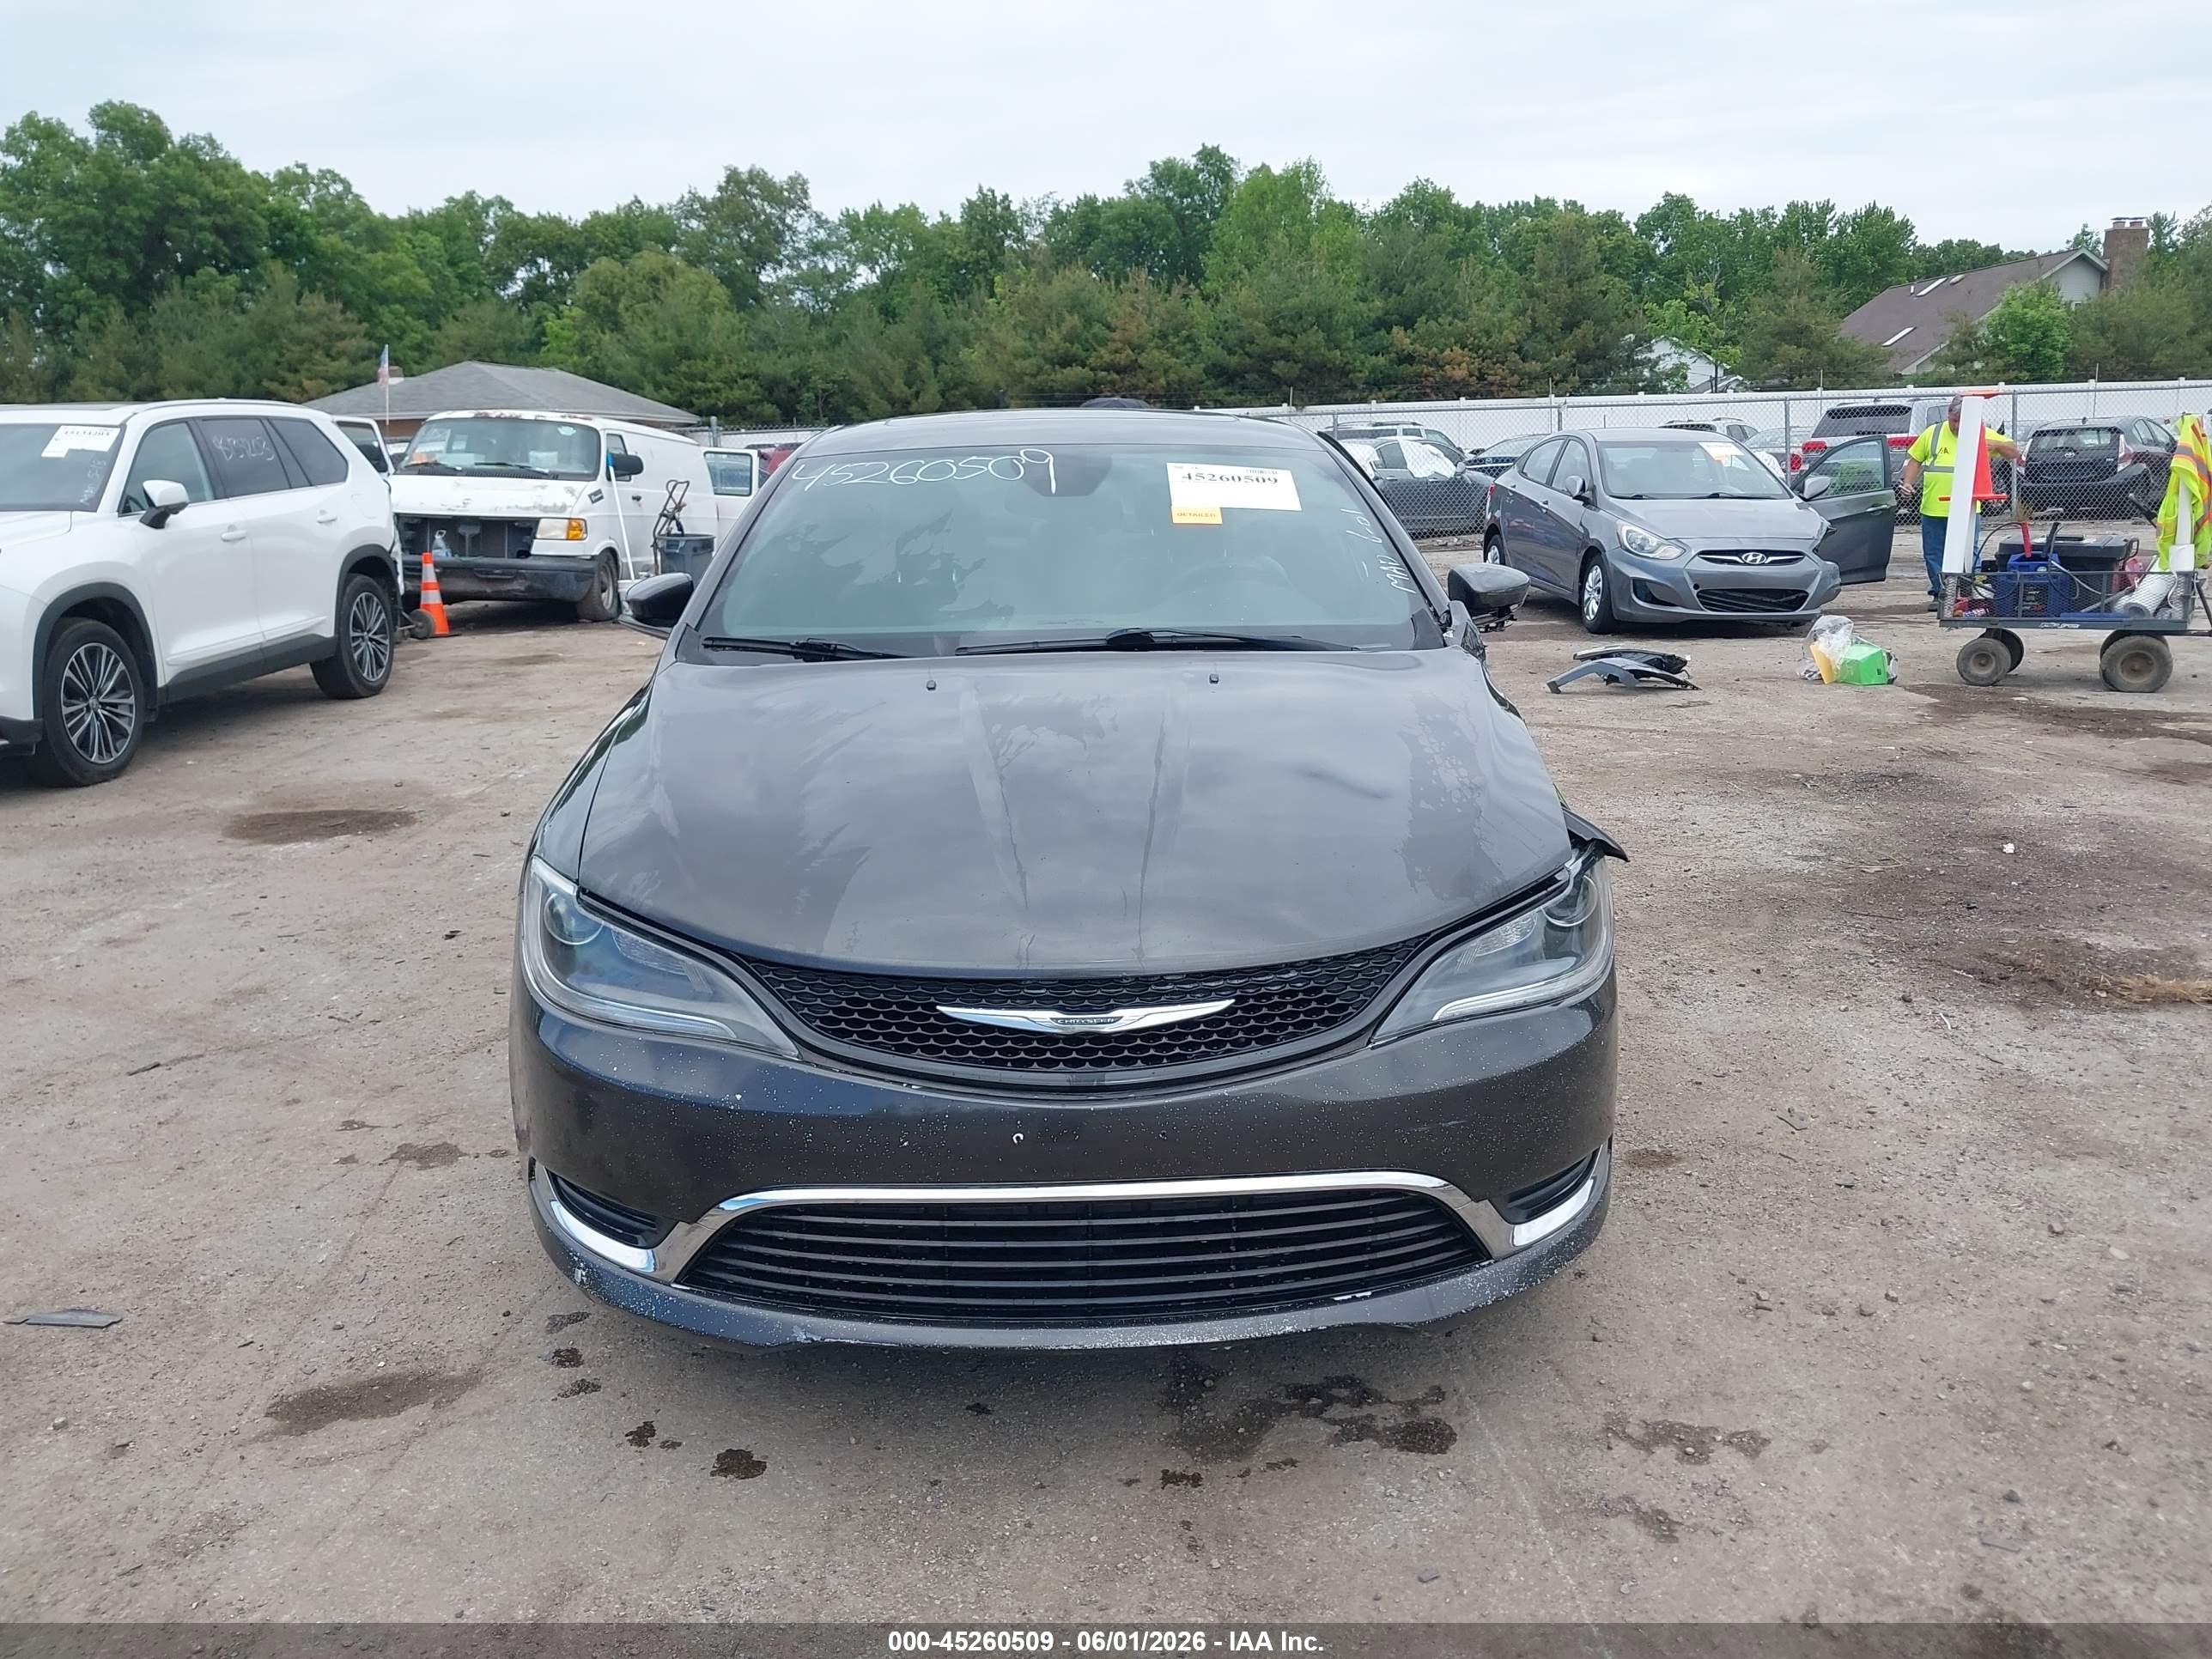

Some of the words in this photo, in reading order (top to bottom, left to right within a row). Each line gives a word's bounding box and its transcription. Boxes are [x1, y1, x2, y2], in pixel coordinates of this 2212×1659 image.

[791, 448, 1056, 495] 45260509
[1182, 471, 1279, 485] 45260509
[1376, 554, 1417, 594] MAD
